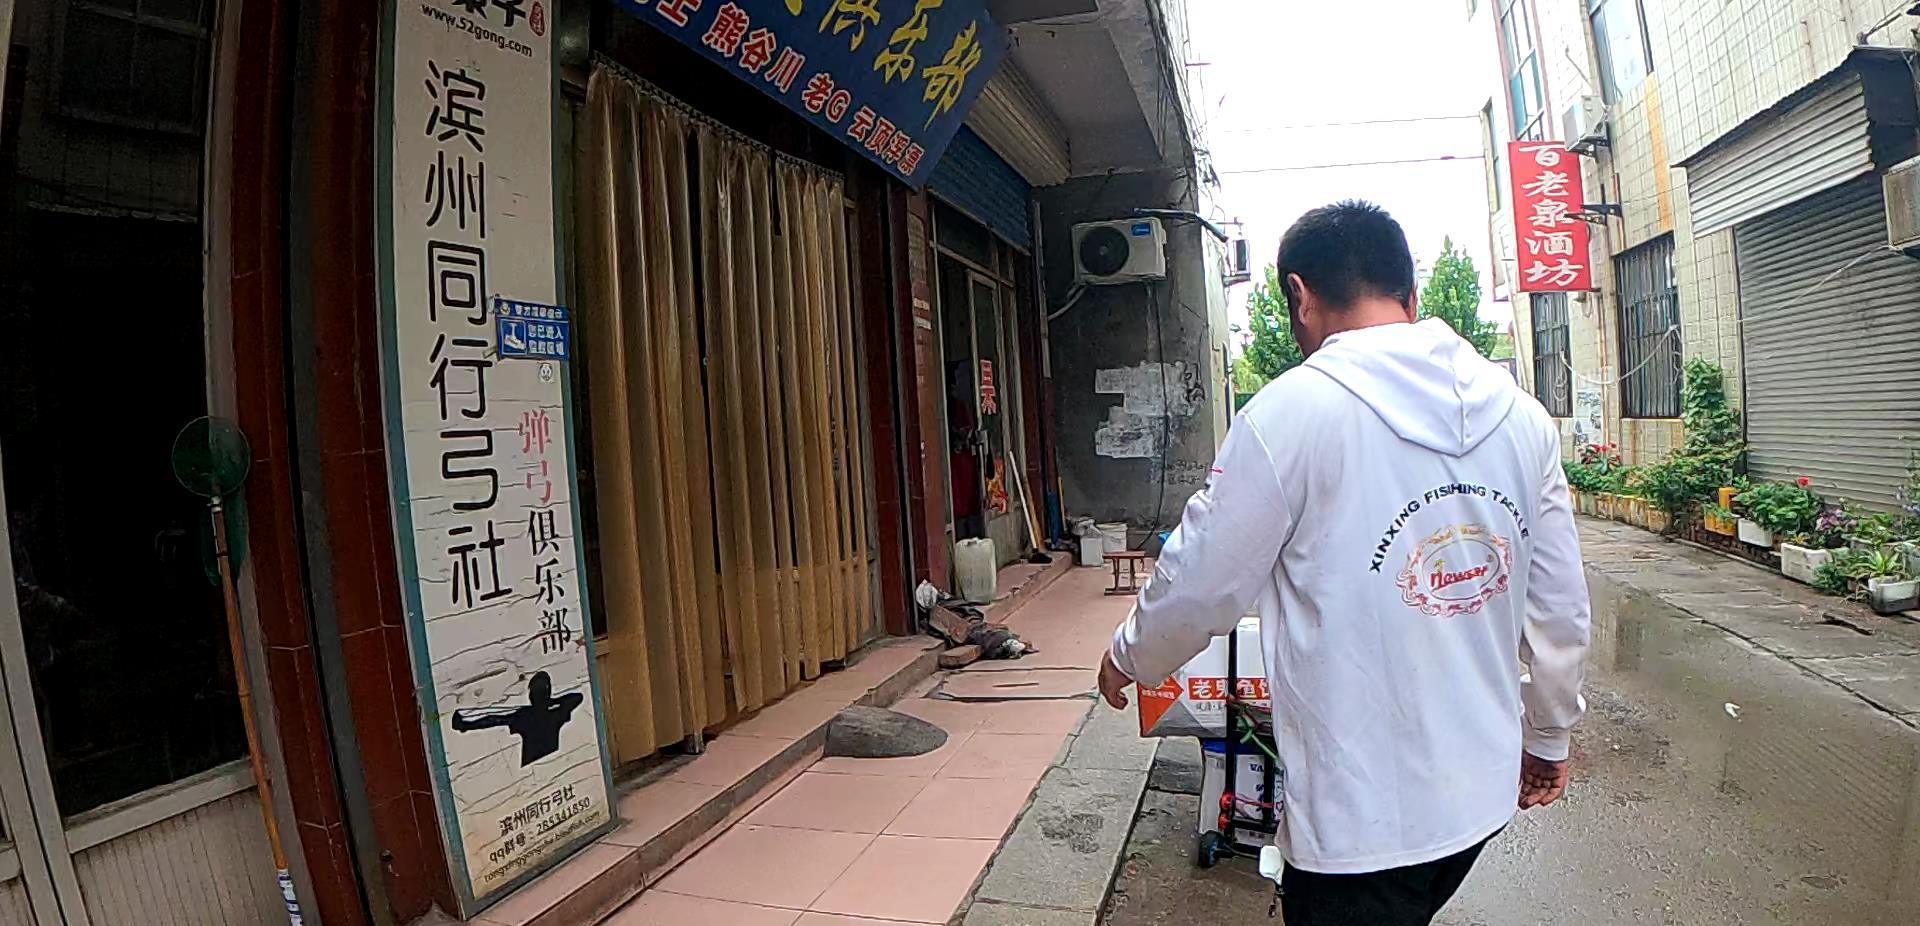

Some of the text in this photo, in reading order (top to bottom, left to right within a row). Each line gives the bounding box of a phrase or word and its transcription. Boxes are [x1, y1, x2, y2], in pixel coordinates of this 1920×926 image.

[421, 4, 533, 57] www.52gong.com
[702, 2, 806, 93] 熊谷川
[802, 72, 851, 124] 老G
[847, 106, 925, 176] 云顶浮漂
[1518, 143, 1584, 288] 百老泉酒坊
[423, 59, 514, 609] 滨州同行弓社
[519, 409, 572, 654] 弹弓俱乐部
[1369, 500, 1421, 573] XINXING
[1491, 489, 1530, 540] TACKLE
[499, 784, 576, 837] 滨州同行弓社
